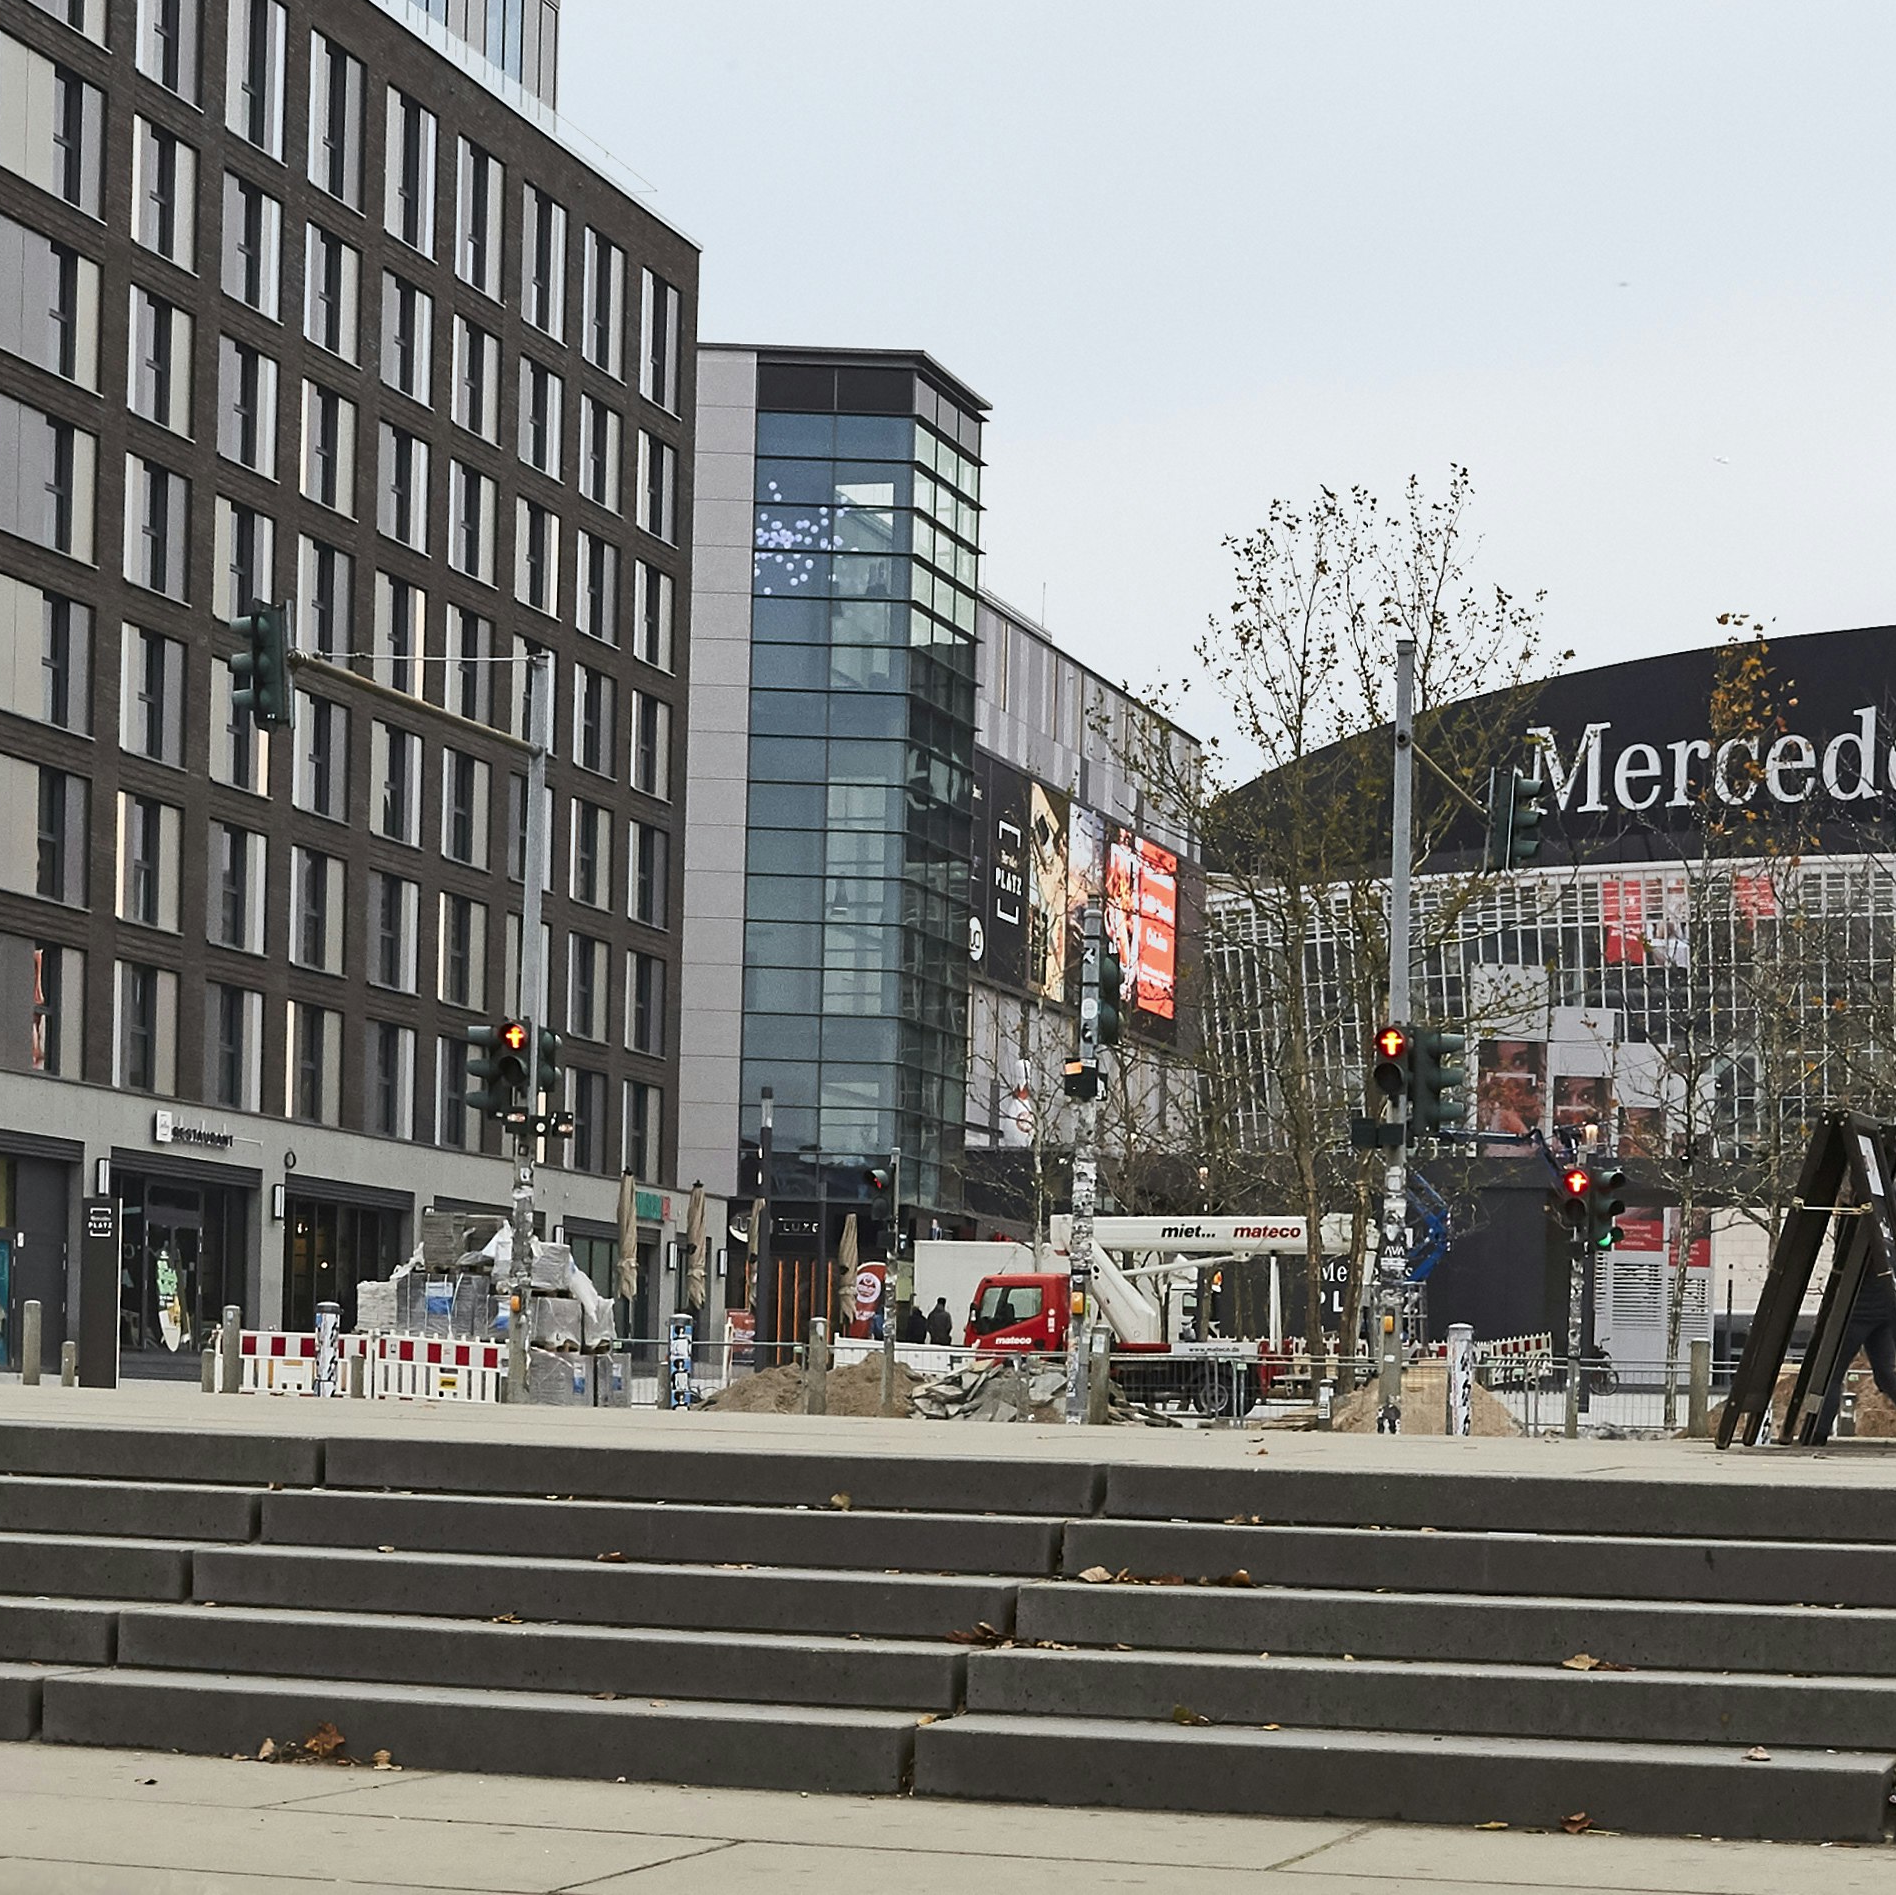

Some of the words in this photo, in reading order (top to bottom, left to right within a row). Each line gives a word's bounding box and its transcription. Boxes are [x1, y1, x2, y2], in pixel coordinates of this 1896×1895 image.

[995, 866, 1022, 897] PLATZ
[1161, 1223, 1216, 1238] miet...
[1233, 1225, 1301, 1238] mateco
[995, 1336, 1032, 1345] mateco
